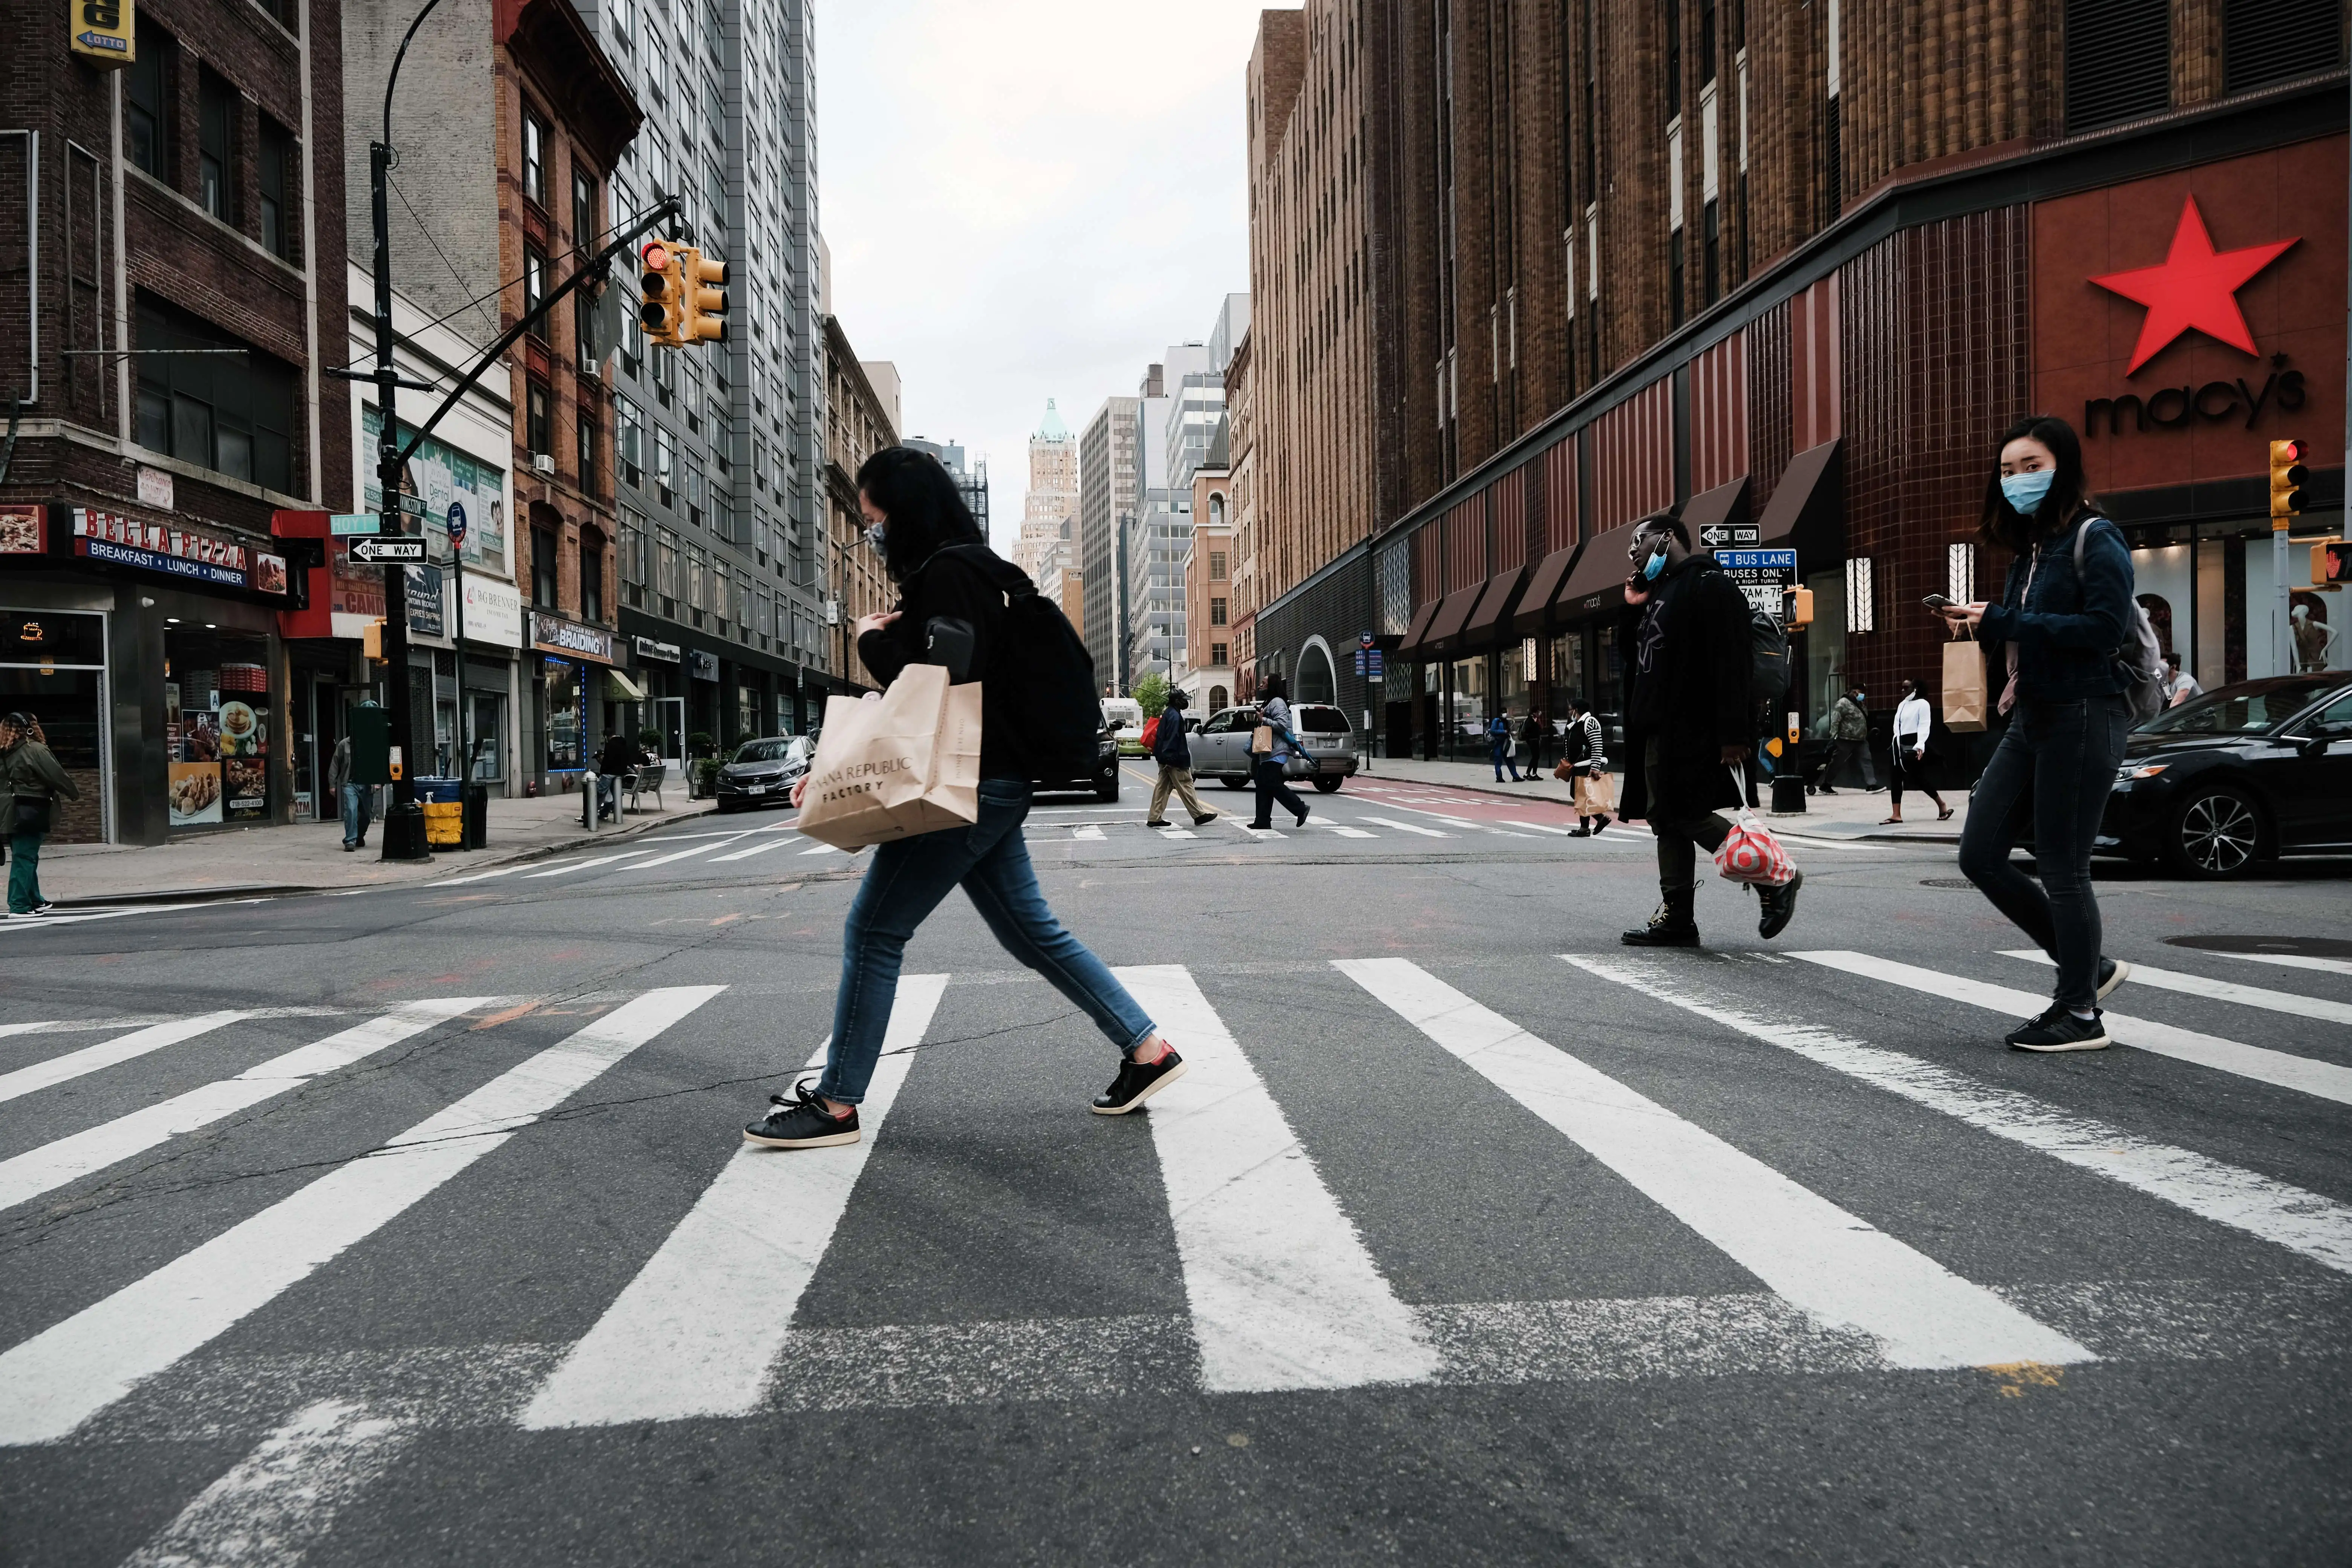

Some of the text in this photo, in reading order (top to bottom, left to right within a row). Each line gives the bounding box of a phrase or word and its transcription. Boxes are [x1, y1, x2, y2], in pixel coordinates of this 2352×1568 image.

[87, 34, 124, 48] LOTTO
[430, 483, 449, 502] Dental
[400, 495, 421, 515] IVINGSTON
[429, 497, 447, 514] Studio
[333, 517, 368, 531] HOYT
[85, 508, 247, 570] BELLA PIZZA
[1707, 531, 1726, 540] ONE
[361, 546, 416, 555] ONE WAY
[91, 542, 242, 584] BREAKFAST LUNCH DINNER
[1736, 554, 1791, 565] BUS LANE
[1724, 569, 1757, 578] BUSES
[1741, 588, 1762, 598] 7AM
[1770, 588, 1782, 597] 7P
[345, 593, 385, 616] CAND
[489, 593, 518, 611] BRENNER
[1749, 601, 1764, 611] ON
[410, 608, 440, 622] EXPRESS SHIPPING
[487, 609, 501, 617] INCOME
[542, 619, 557, 632] Pretty
[565, 624, 584, 634] AFRICAN
[548, 629, 560, 645] Lady
[559, 629, 599, 654] BRAIDING
[212, 695, 218, 706] A
[809, 757, 913, 790] ANANA REPUBLIC
[822, 781, 883, 803] FACTORY
[295, 801, 310, 814] ATM
[1387, 796, 1521, 806] BUS
